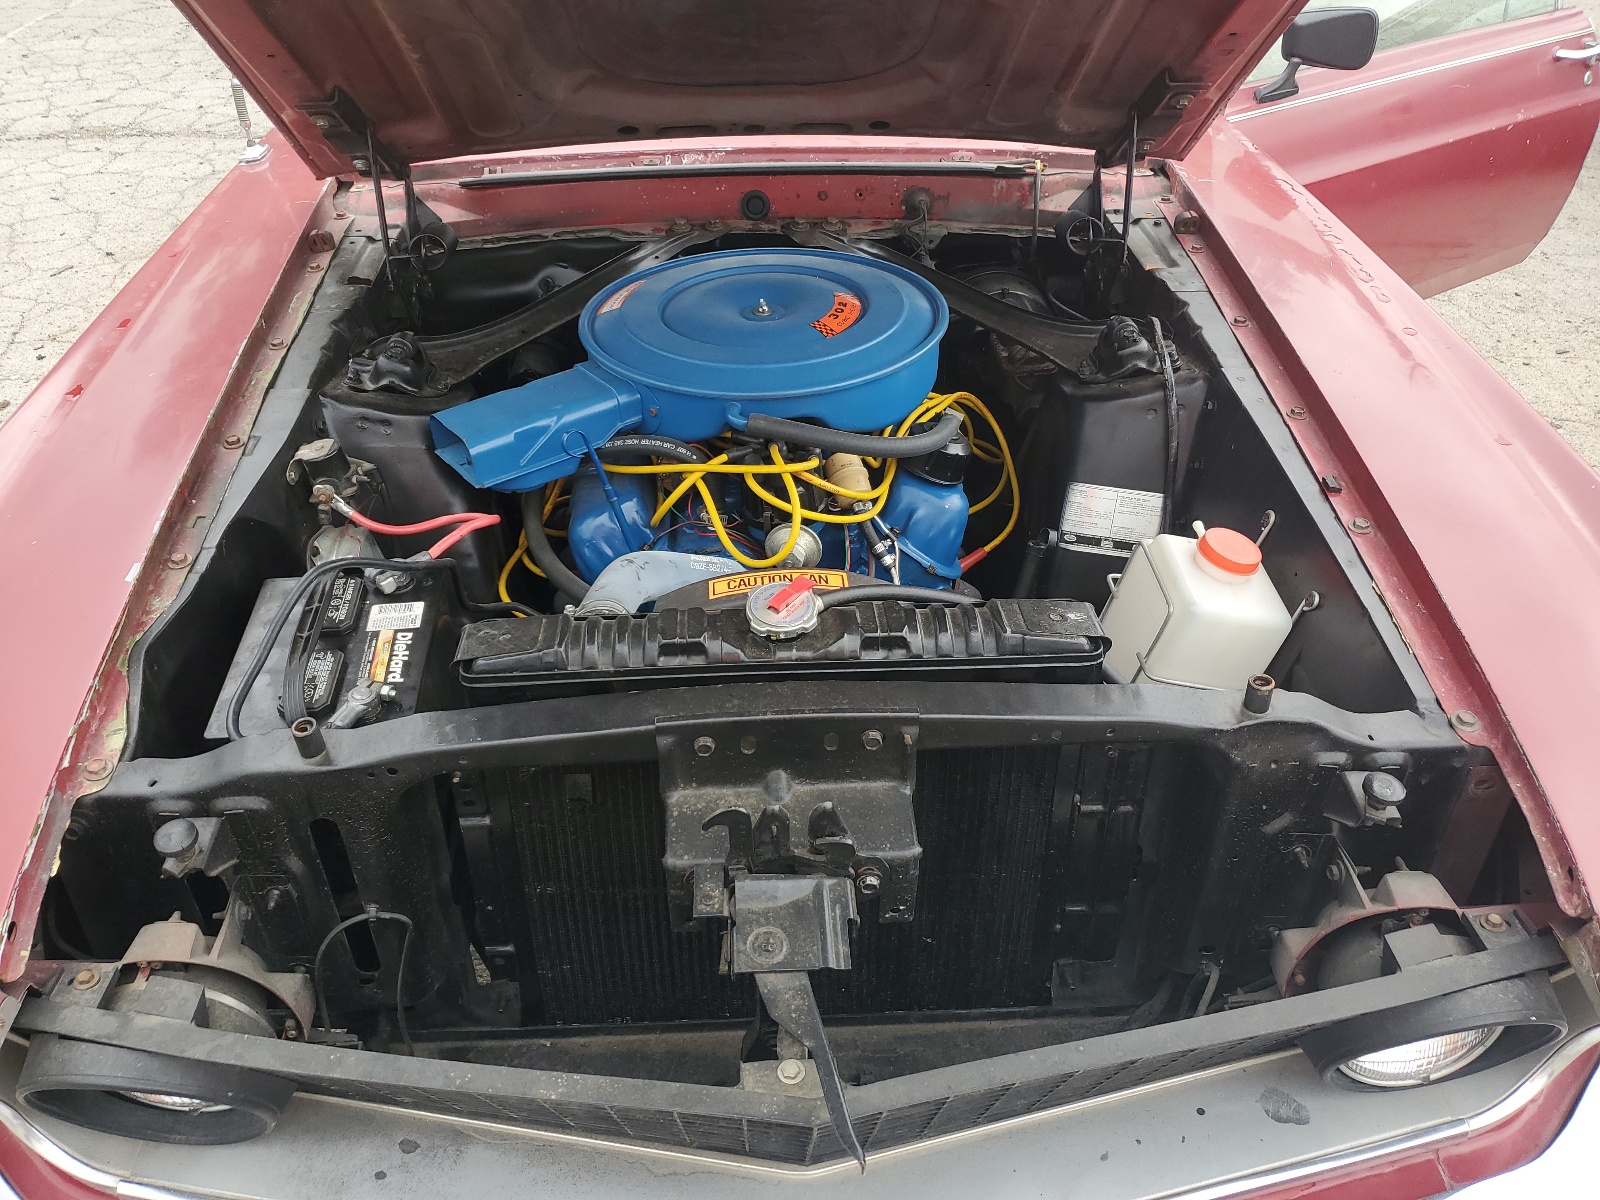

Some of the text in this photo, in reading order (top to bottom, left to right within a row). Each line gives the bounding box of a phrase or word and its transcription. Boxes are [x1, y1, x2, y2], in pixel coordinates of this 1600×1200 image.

[828, 302, 847, 319] 302
[640, 438, 662, 447] HEATER
[663, 441, 676, 450] CAR
[727, 573, 829, 590] CAUTION AN
[387, 632, 414, 683] DieHard
